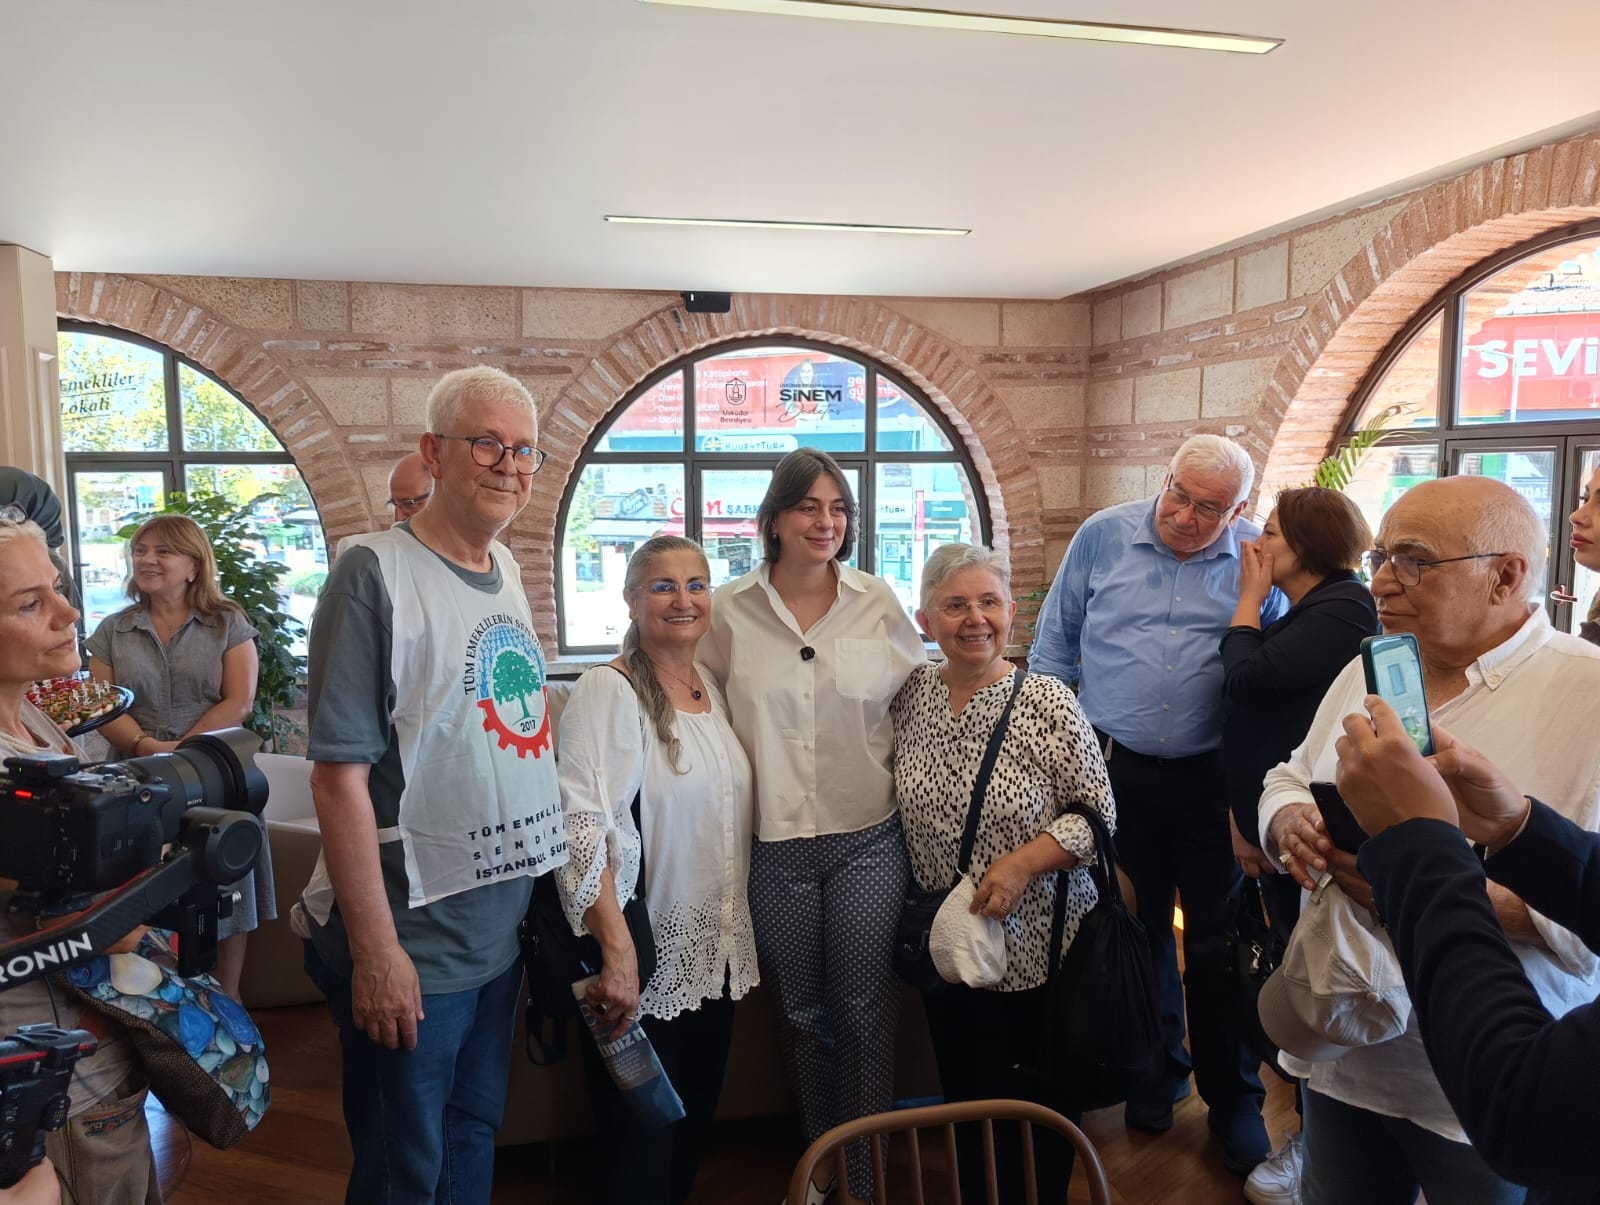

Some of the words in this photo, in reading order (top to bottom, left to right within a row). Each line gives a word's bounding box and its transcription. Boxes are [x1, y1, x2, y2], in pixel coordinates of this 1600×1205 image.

[720, 416, 752, 424] Belediyesi
[671, 497, 723, 516] Cn
[466, 612, 513, 659] EMEKLİLERİN
[462, 662, 476, 695] TÜM
[520, 719, 536, 732] 2017
